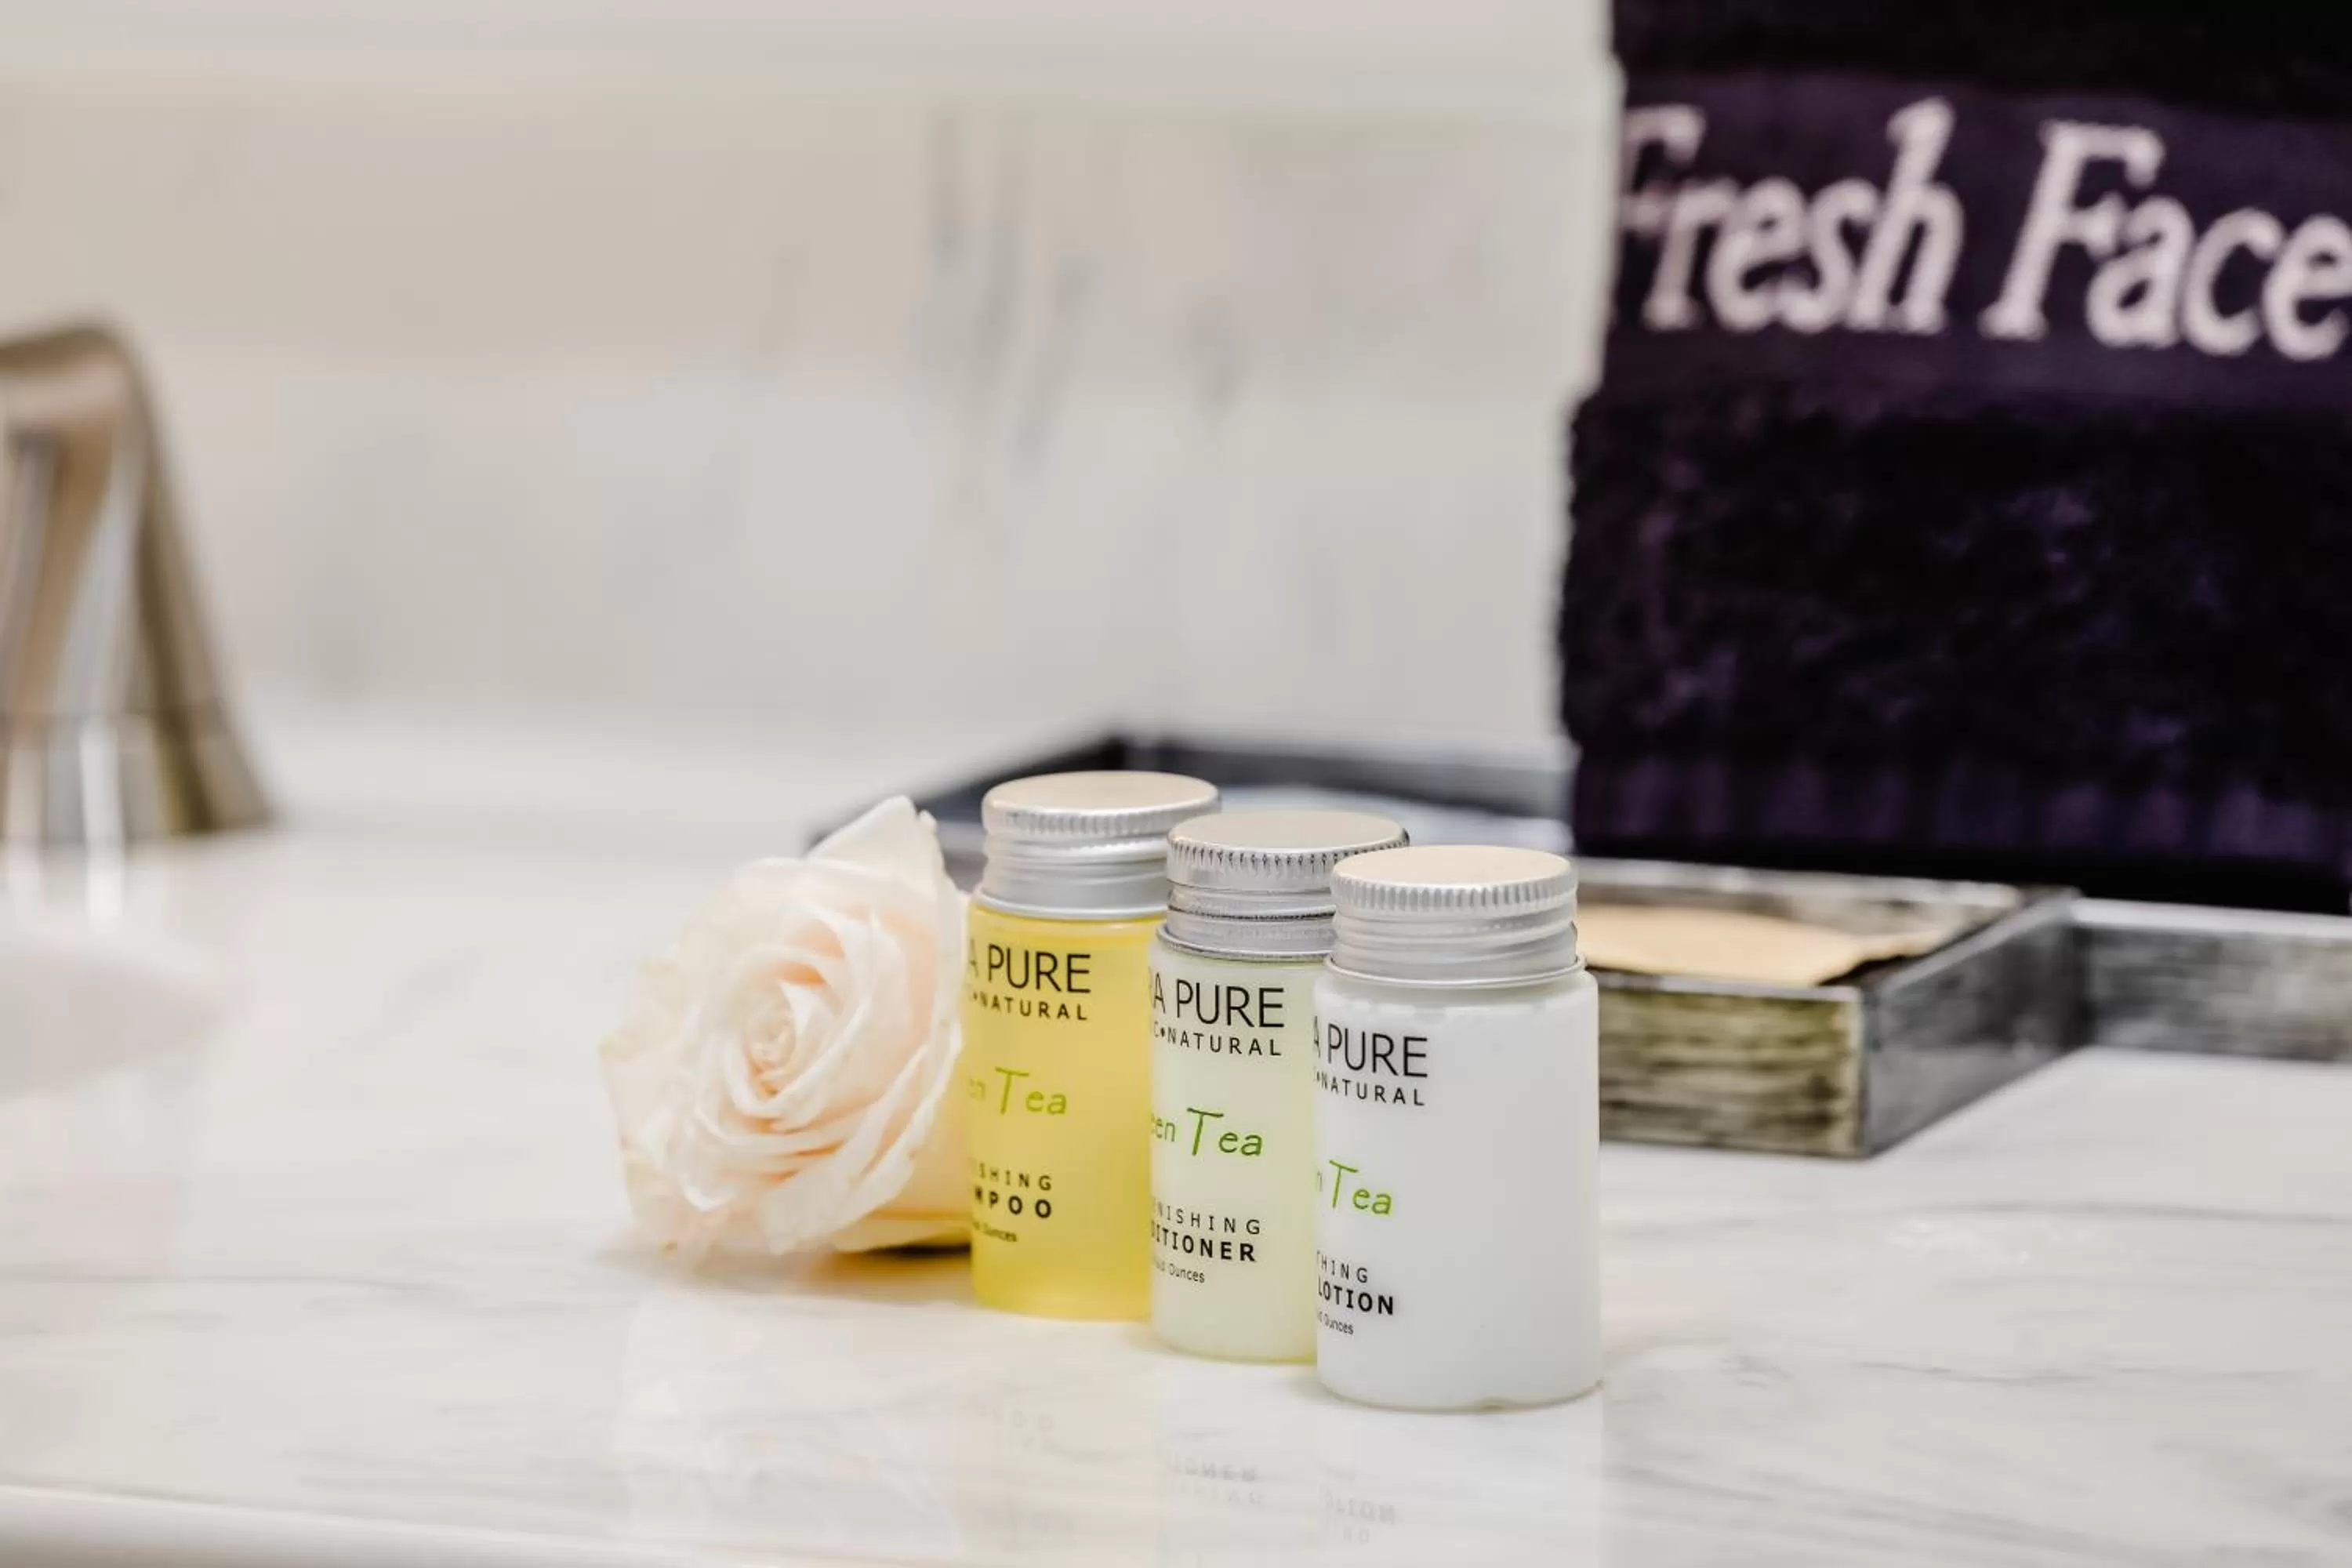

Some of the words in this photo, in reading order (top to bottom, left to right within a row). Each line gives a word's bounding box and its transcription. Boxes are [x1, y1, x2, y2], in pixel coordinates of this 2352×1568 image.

[1620, 97, 1962, 332] Fresh
[1979, 119, 2352, 361] Face
[988, 943, 1091, 994] PURE
[1176, 978, 1285, 1029] PURE
[1327, 1022, 1428, 1078] PURE
[995, 1066, 1068, 1116] Tea
[1186, 1107, 1263, 1157] Tea
[1329, 1159, 1392, 1215] Tea
